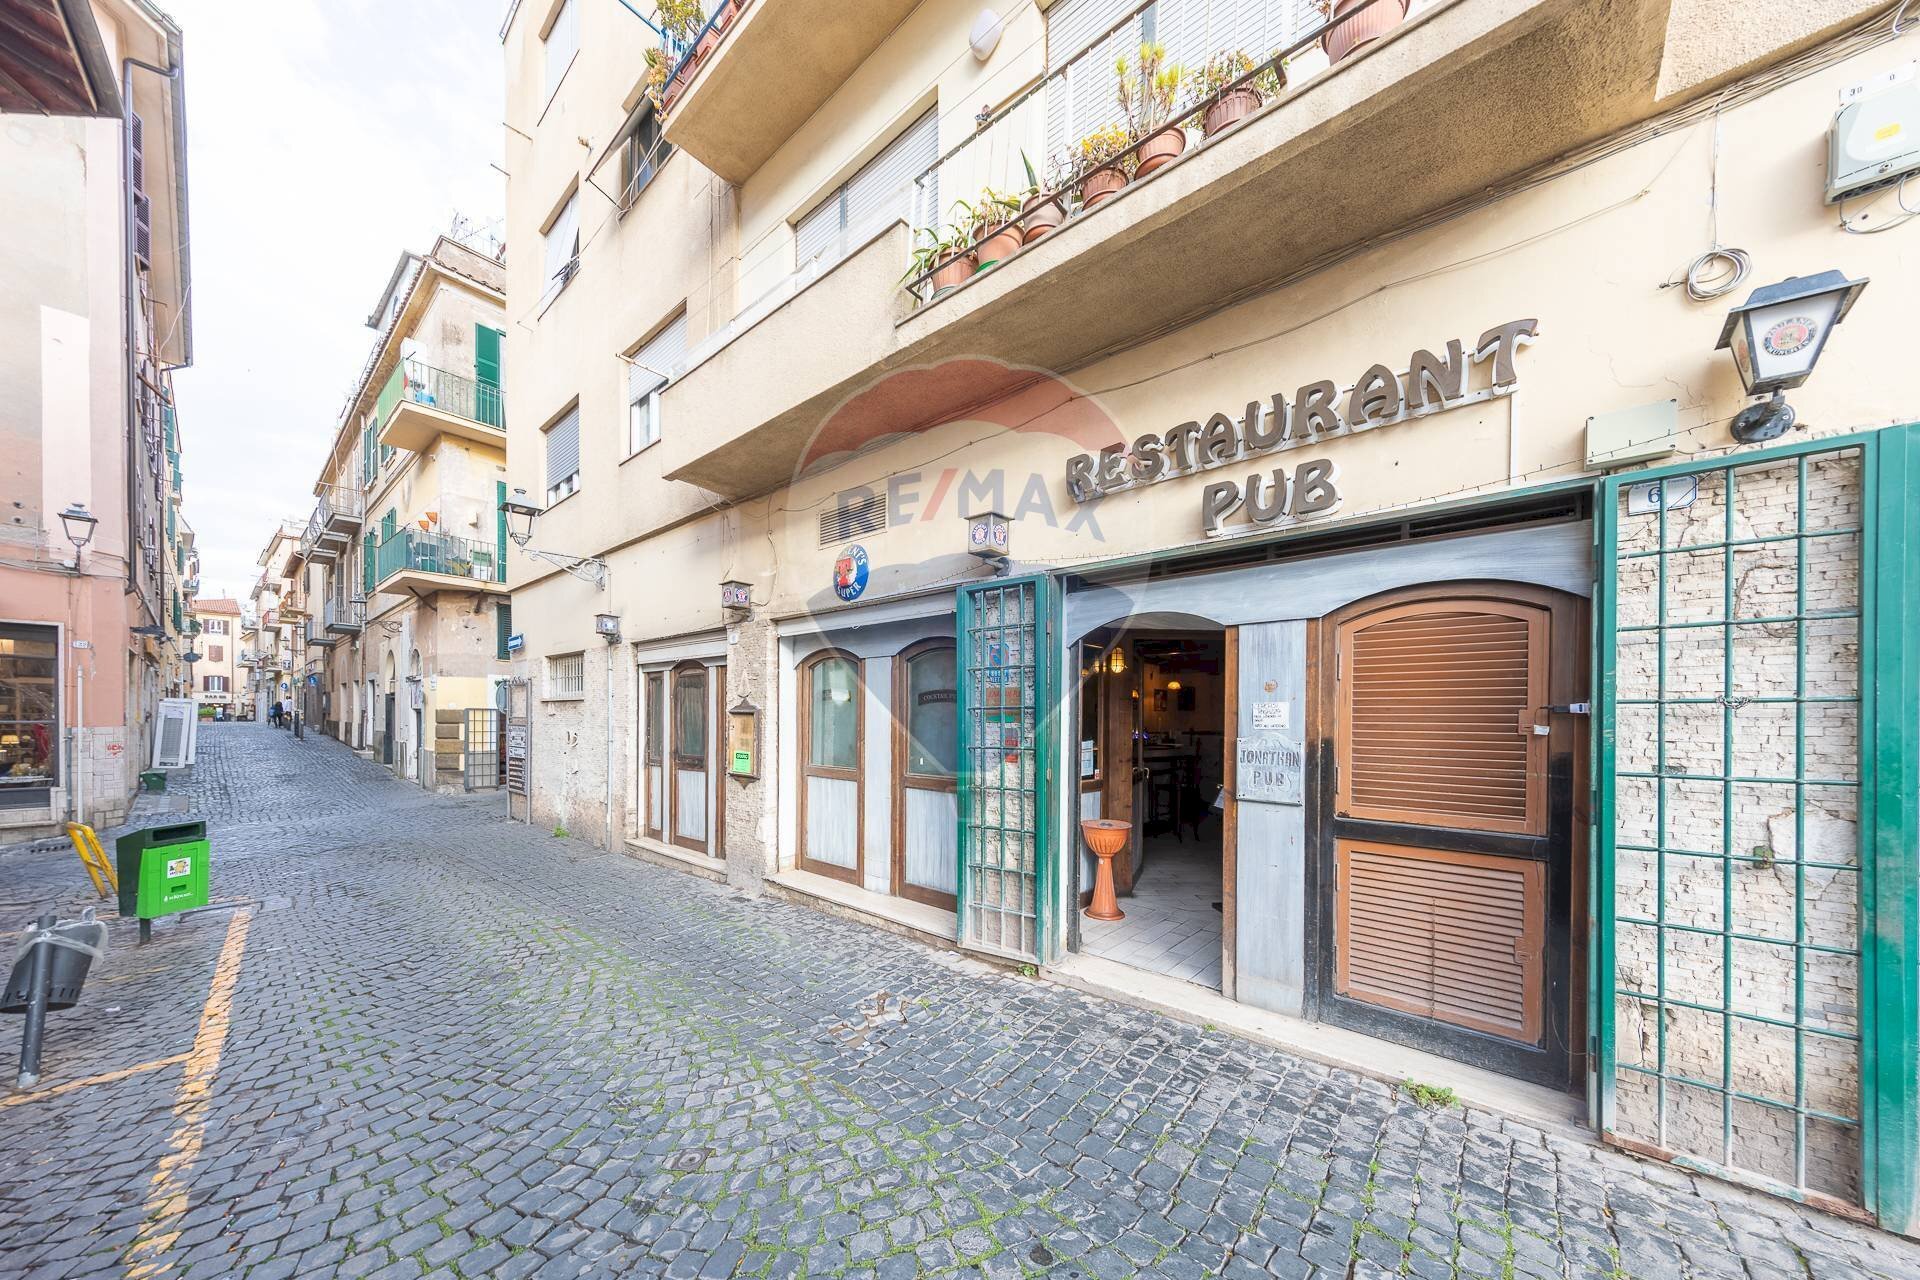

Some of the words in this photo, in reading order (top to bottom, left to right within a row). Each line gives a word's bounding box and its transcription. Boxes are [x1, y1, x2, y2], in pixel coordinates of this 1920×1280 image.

[1066, 318, 1540, 503] RESTAURANT
[1202, 458, 1342, 537] PUB
[836, 582, 862, 598] SUPER
[1239, 749, 1301, 768] JONATHAN
[1253, 770, 1285, 787] PUB
